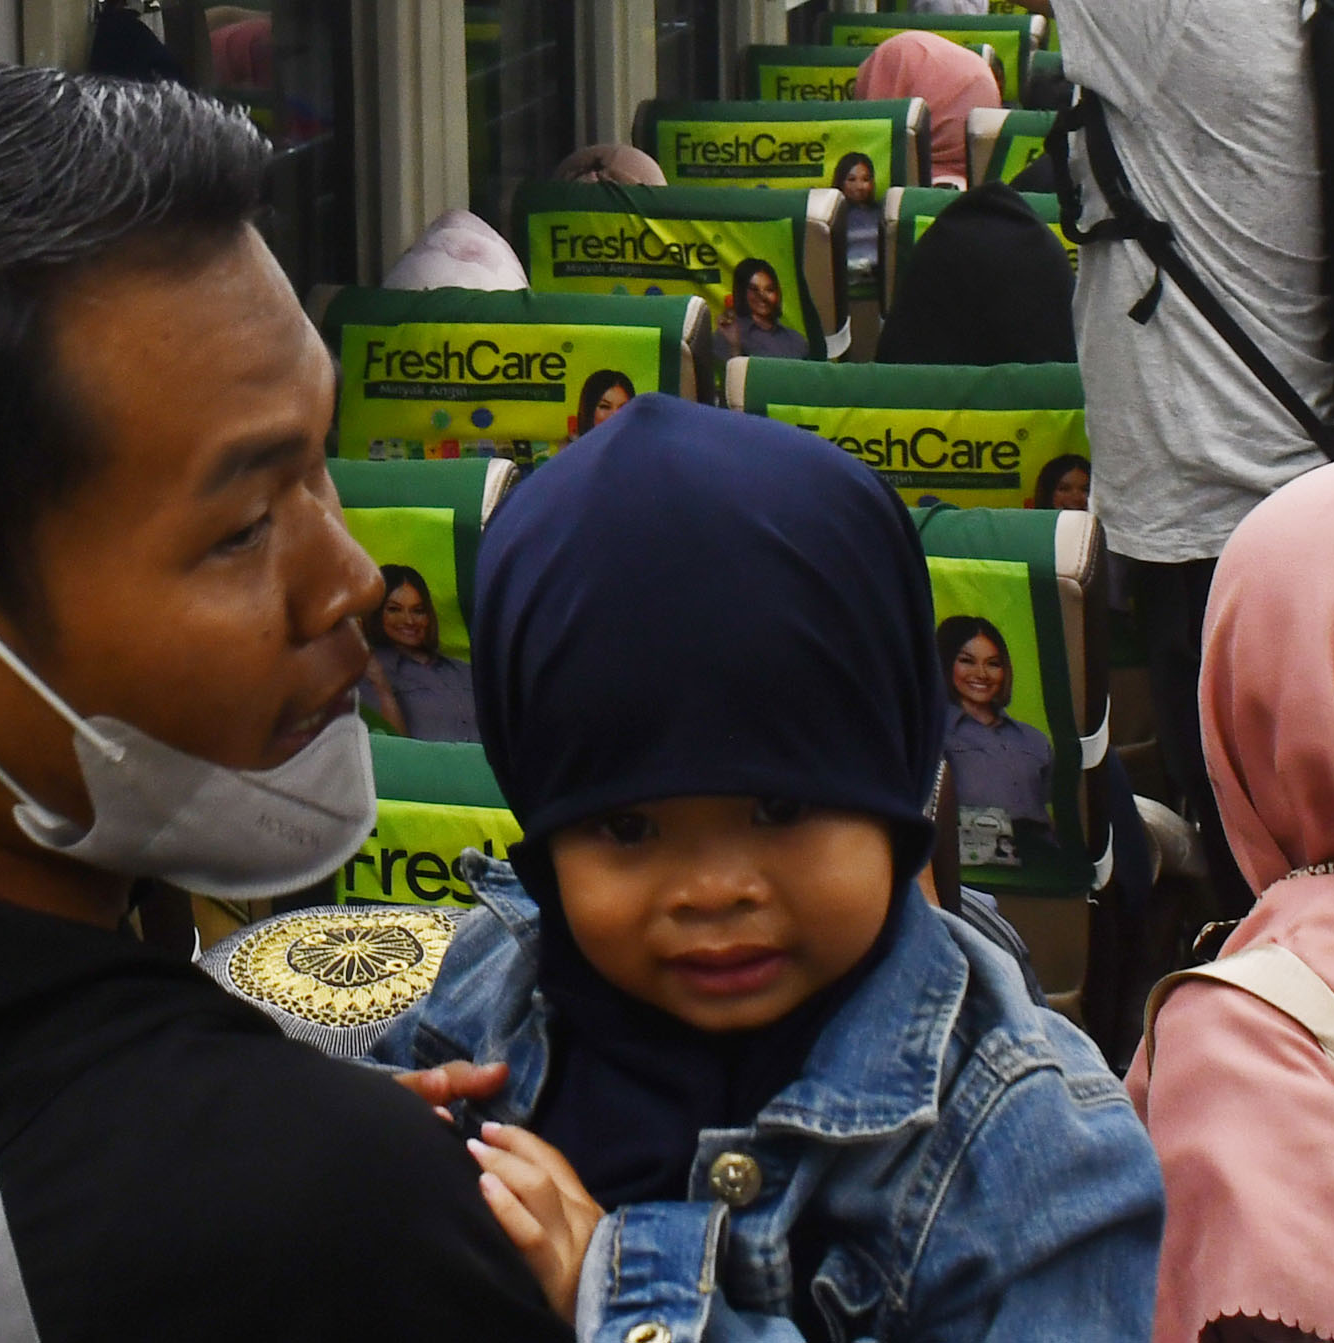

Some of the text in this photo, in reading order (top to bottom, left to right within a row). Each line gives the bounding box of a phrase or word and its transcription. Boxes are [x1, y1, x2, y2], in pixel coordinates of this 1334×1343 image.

[675, 132, 825, 164] FreshCare
[550, 224, 718, 267] FreshCare
[364, 339, 567, 381] FreshCare
